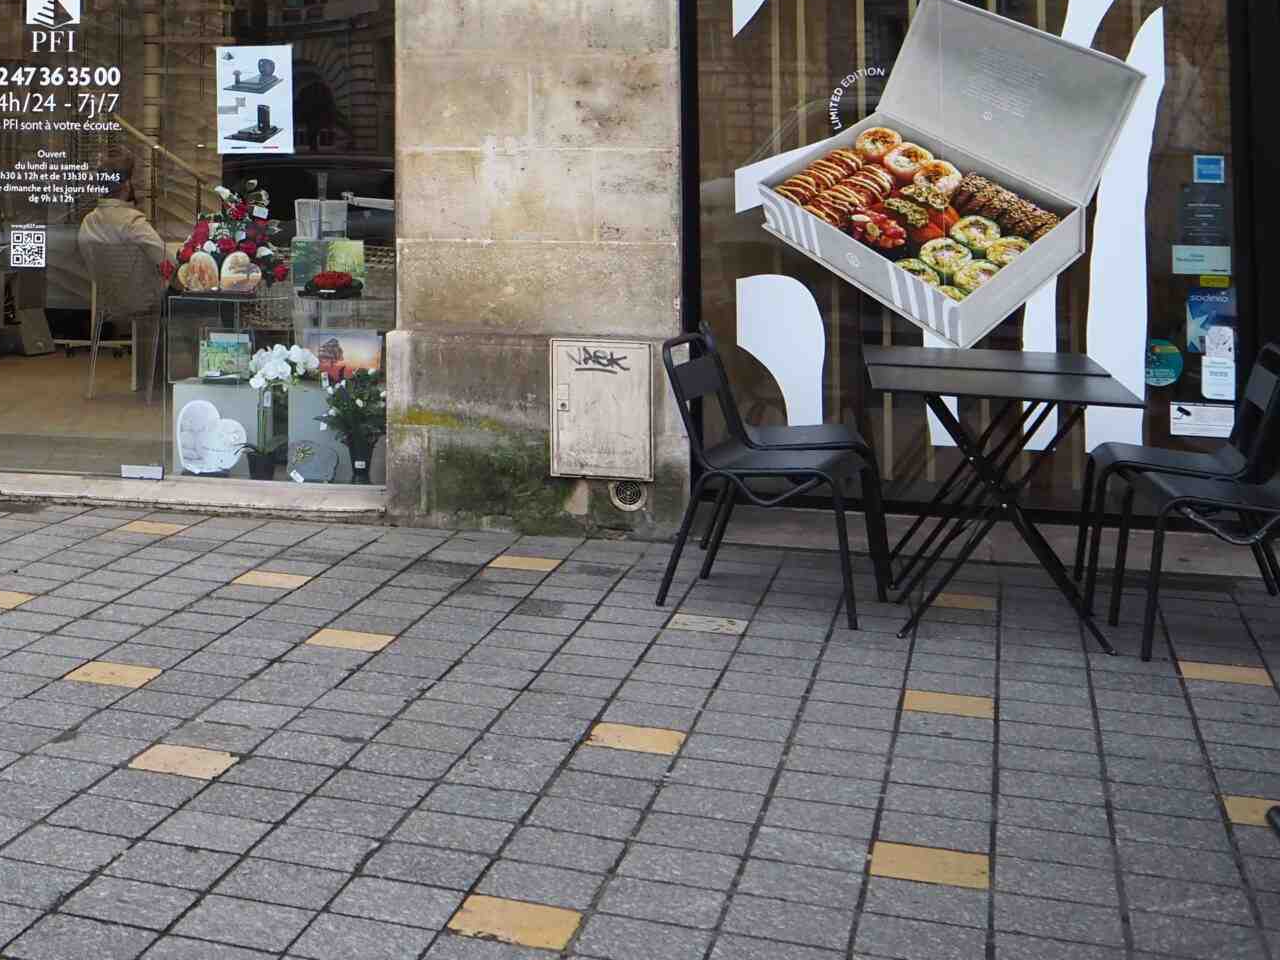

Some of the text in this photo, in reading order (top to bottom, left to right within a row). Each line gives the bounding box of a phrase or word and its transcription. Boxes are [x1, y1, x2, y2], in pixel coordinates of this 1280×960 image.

[31, 30, 78, 53] PFI
[10, 67, 37, 87] 47
[39, 67, 64, 87] 36
[67, 67, 91, 87] 35
[94, 66, 121, 87] 00
[829, 67, 885, 130] LIMITED EDITION
[78, 93, 120, 119] 7j/7
[3, 119, 19, 130] PFI
[21, 120, 43, 130] sont
[45, 120, 51, 130] à
[54, 121, 81, 131] votre
[83, 120, 122, 131] écoute.
[37, 150, 66, 158] Ouvert
[17, 172, 22, 180] à
[24, 172, 38, 180] 12h
[40, 172, 49, 180] et
[50, 172, 60, 180] de
[88, 172, 94, 180] à
[3, 183, 42, 192] dimanche
[43, 184, 51, 192] et
[53, 184, 64, 192] les
[65, 184, 85, 194] jours
[28, 195, 39, 203] de
[40, 194, 51, 203] 9h
[60, 194, 74, 203] 12h
